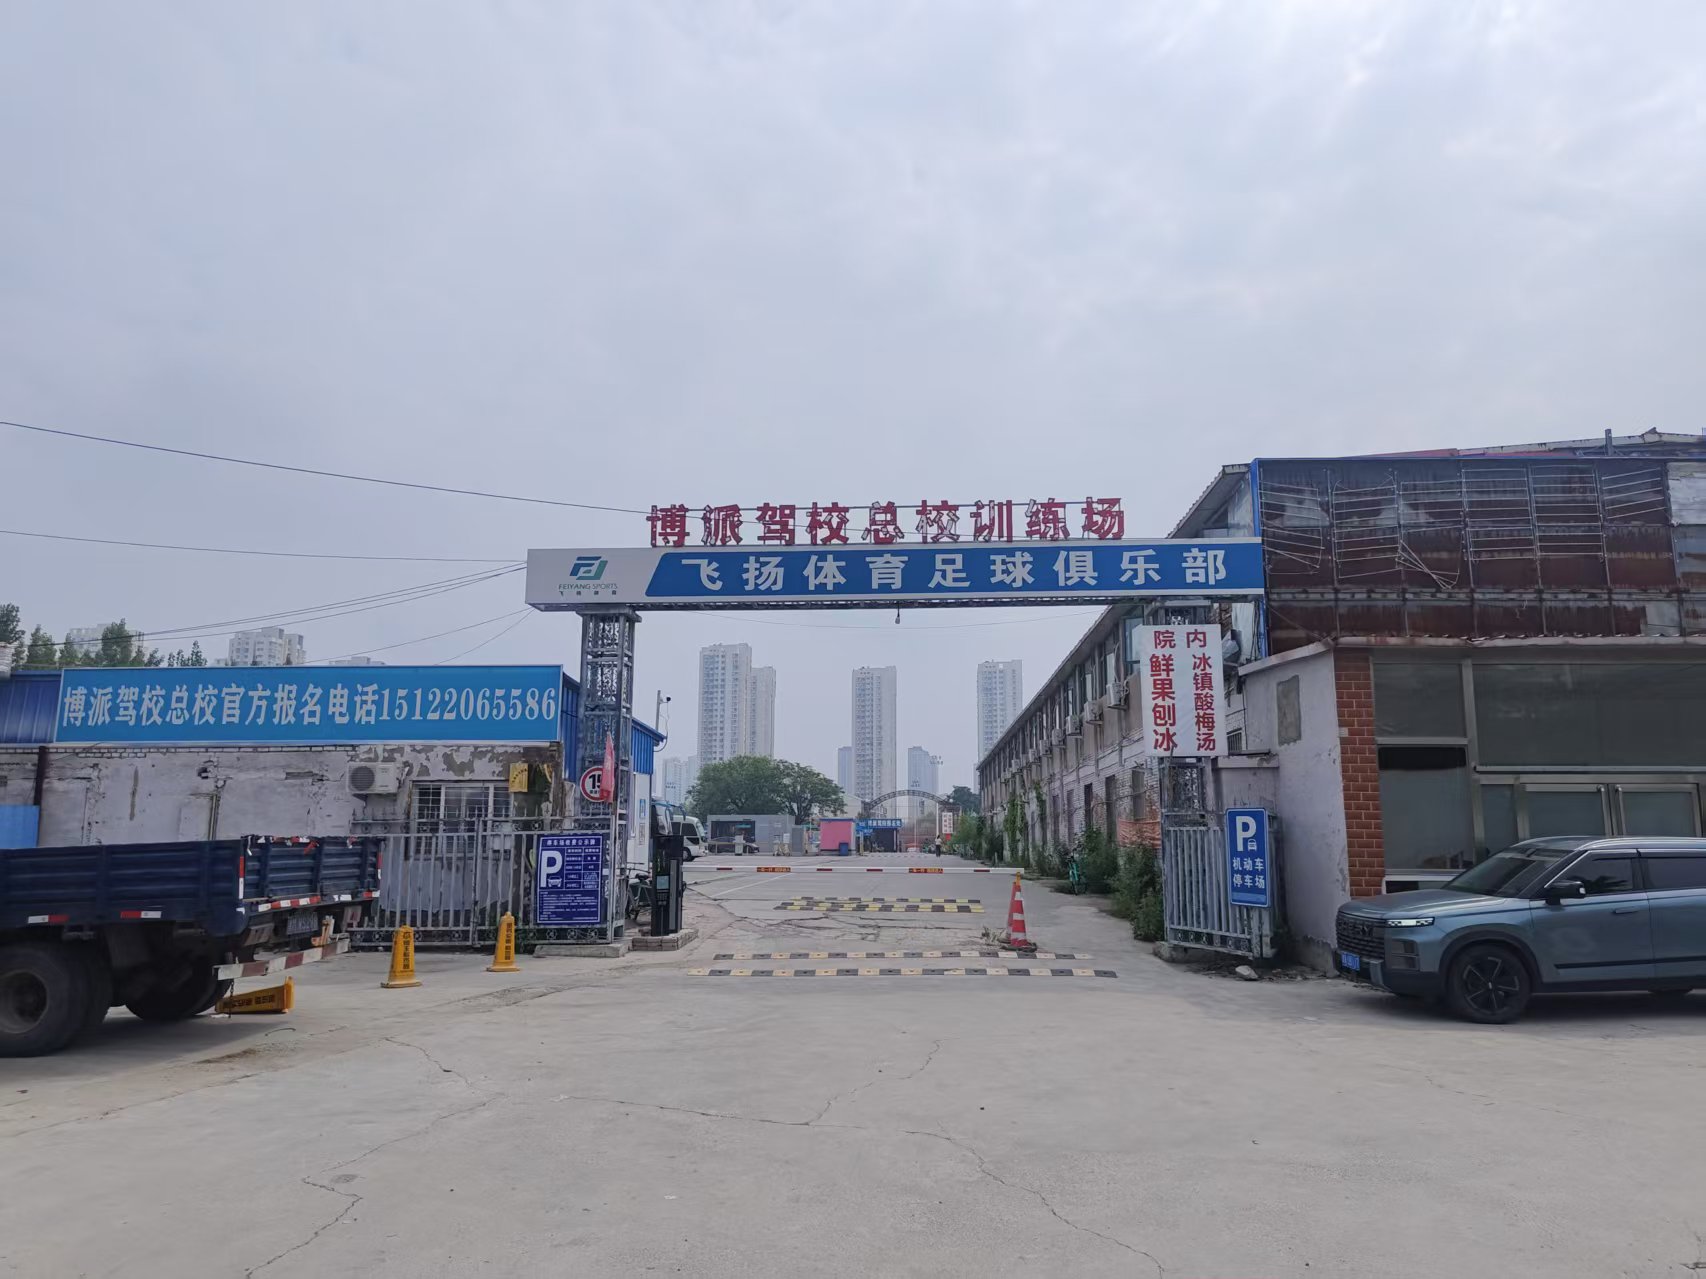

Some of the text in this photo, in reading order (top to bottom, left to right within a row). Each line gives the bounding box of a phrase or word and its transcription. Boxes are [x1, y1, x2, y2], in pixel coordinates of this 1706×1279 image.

[646, 497, 1124, 547] 博派驾校总校训练场
[681, 548, 1226, 591] 飞扬体育足球俱乐部
[1153, 629, 1207, 649] 院内
[63, 683, 556, 727] 博派驾校总校官方报名电话15122065586
[1149, 653, 1178, 752] 鲜果刨冰
[1192, 652, 1216, 752] 冰镇酸梅汤
[1235, 815, 1257, 852] P
[540, 850, 563, 888] P
[1232, 857, 1265, 872] 机动车
[1232, 873, 1265, 889] 停车场
